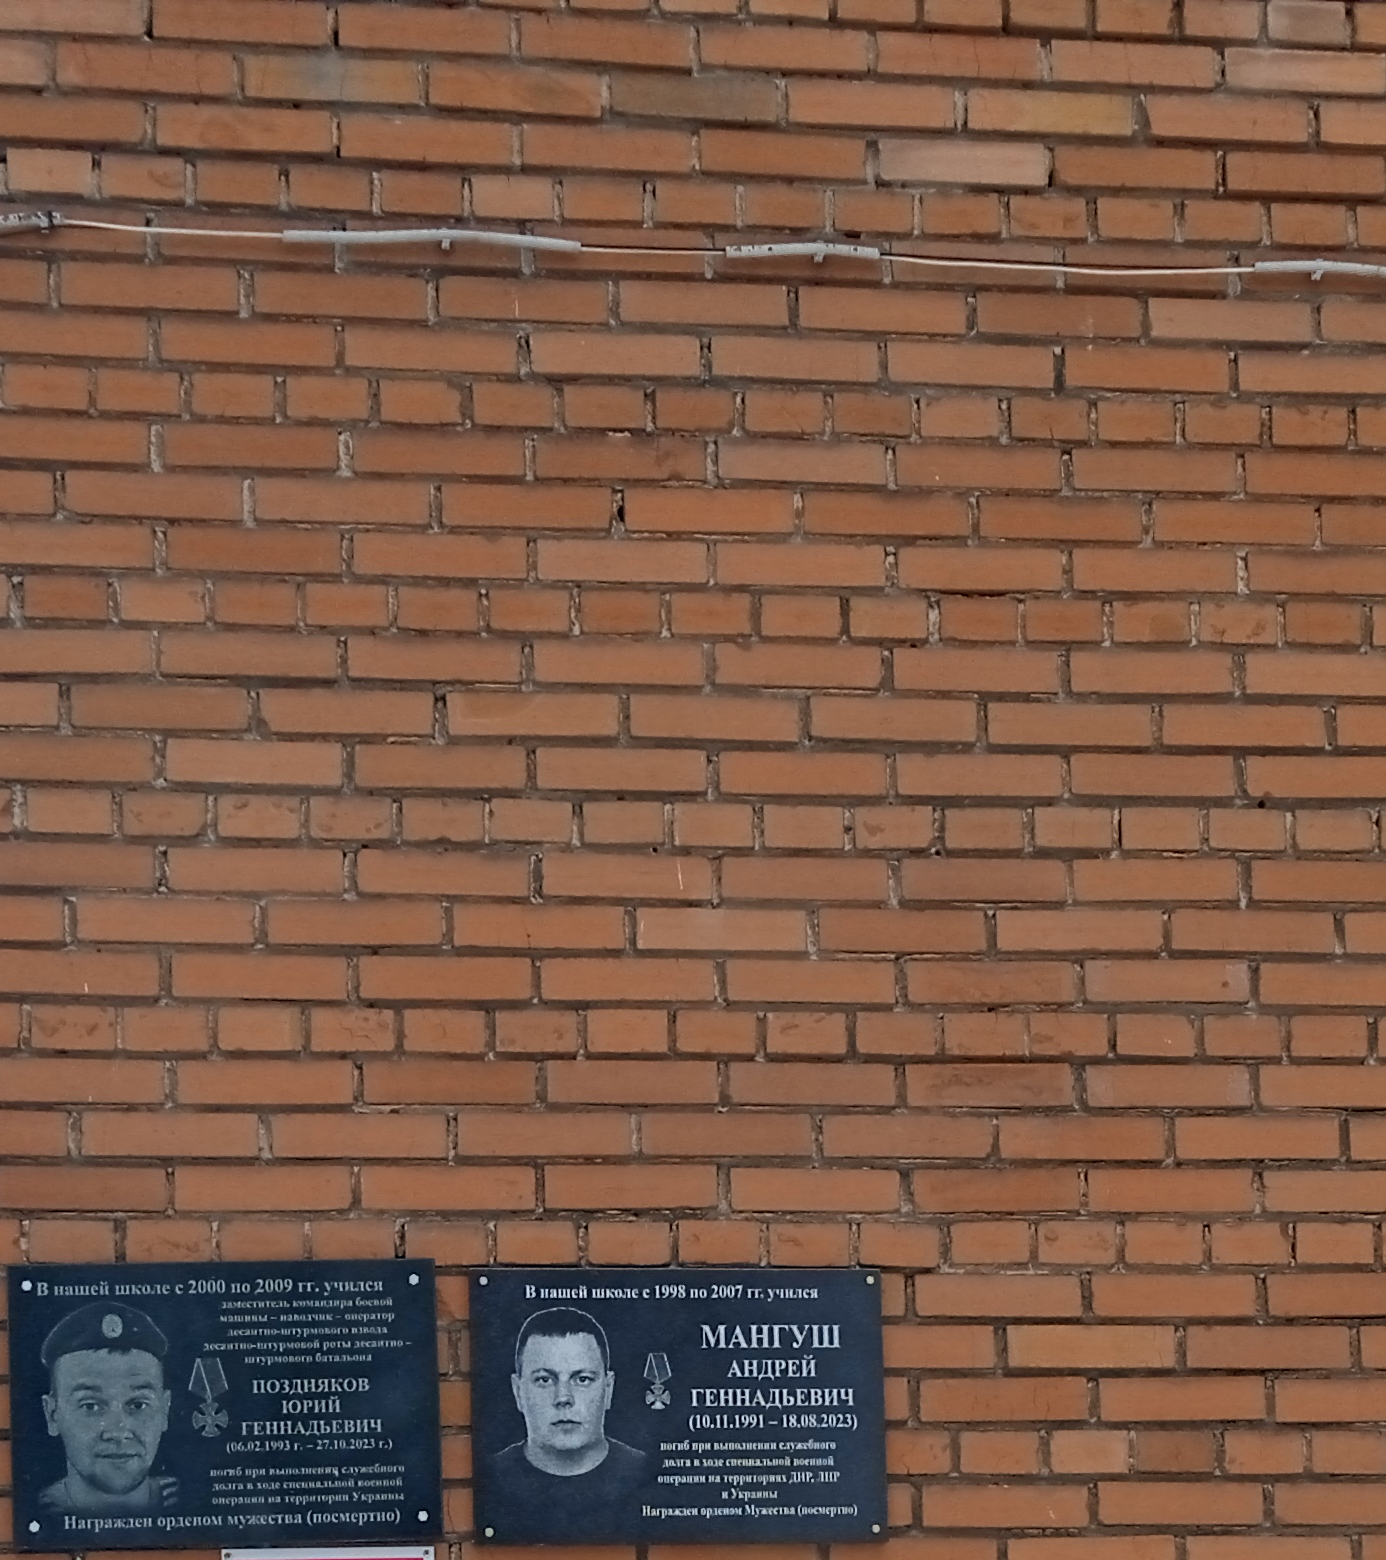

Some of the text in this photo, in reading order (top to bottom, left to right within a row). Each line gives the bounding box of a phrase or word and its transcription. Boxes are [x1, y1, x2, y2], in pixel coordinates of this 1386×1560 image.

[36, 1282, 48, 1296] В
[54, 1281, 109, 1296] нашей
[115, 1282, 170, 1295] школе
[175, 1283, 184, 1294] с
[187, 1279, 226, 1294] 2000
[231, 1281, 251, 1293] по
[254, 1278, 293, 1295] 2009
[324, 1280, 383, 1295] учился
[525, 1285, 536, 1299] В
[540, 1286, 587, 1298] нашей
[591, 1288, 639, 1298] школе
[643, 1289, 650, 1298] с
[655, 1285, 686, 1298] 1998
[690, 1288, 707, 1298] по
[711, 1285, 743, 1298] 2007
[768, 1288, 818, 1301] учился
[293, 1299, 353, 1309] командира
[355, 1297, 393, 1307] боевой
[219, 1314, 268, 1322] машины
[345, 1312, 395, 1322] оператор
[227, 1326, 388, 1337] десантно-штурмового взвода
[700, 1324, 841, 1349] МАНГУШ
[203, 1339, 320, 1352] десантно-штурмовой
[323, 1341, 351, 1350] роты
[354, 1339, 403, 1349] десантно
[244, 1352, 372, 1365] штурмового батальона
[727, 1354, 816, 1381] АНДРЕЙ
[252, 1378, 370, 1395] ПОЗДНЯКОВ
[282, 1396, 341, 1414] ЮРИЙ
[691, 1388, 854, 1410] ГЕННАДЬЕВИЧ
[241, 1419, 382, 1436] ГЕННАДЬЕВИЧ
[689, 1414, 764, 1431] (10.11.1991
[782, 1413, 858, 1430] 18.08.2023)
[293, 1441, 304, 1450] г.
[316, 1439, 376, 1450] 27.10.2023
[660, 1440, 690, 1451] погиб
[692, 1443, 711, 1453] при
[779, 1439, 836, 1452] служебного
[662, 1458, 691, 1468] долга
[702, 1459, 724, 1468] ходе
[725, 1456, 791, 1467] специальной
[793, 1455, 834, 1465] военной
[210, 1467, 242, 1477] погиб
[245, 1468, 266, 1478] при
[341, 1463, 405, 1475] служебного
[212, 1477, 403, 1492] долга в ходе специальной военной
[657, 1475, 706, 1486] операции
[817, 1471, 840, 1482] ЛНР
[212, 1496, 265, 1507] операции
[285, 1491, 349, 1504] территории
[352, 1492, 404, 1503] Украины
[721, 1488, 777, 1500] и Украины
[642, 1503, 858, 1518] Награжден орденом Мужества (посмертно)
[64, 1508, 401, 1532] Награжден орденом мужества (посмертно)
